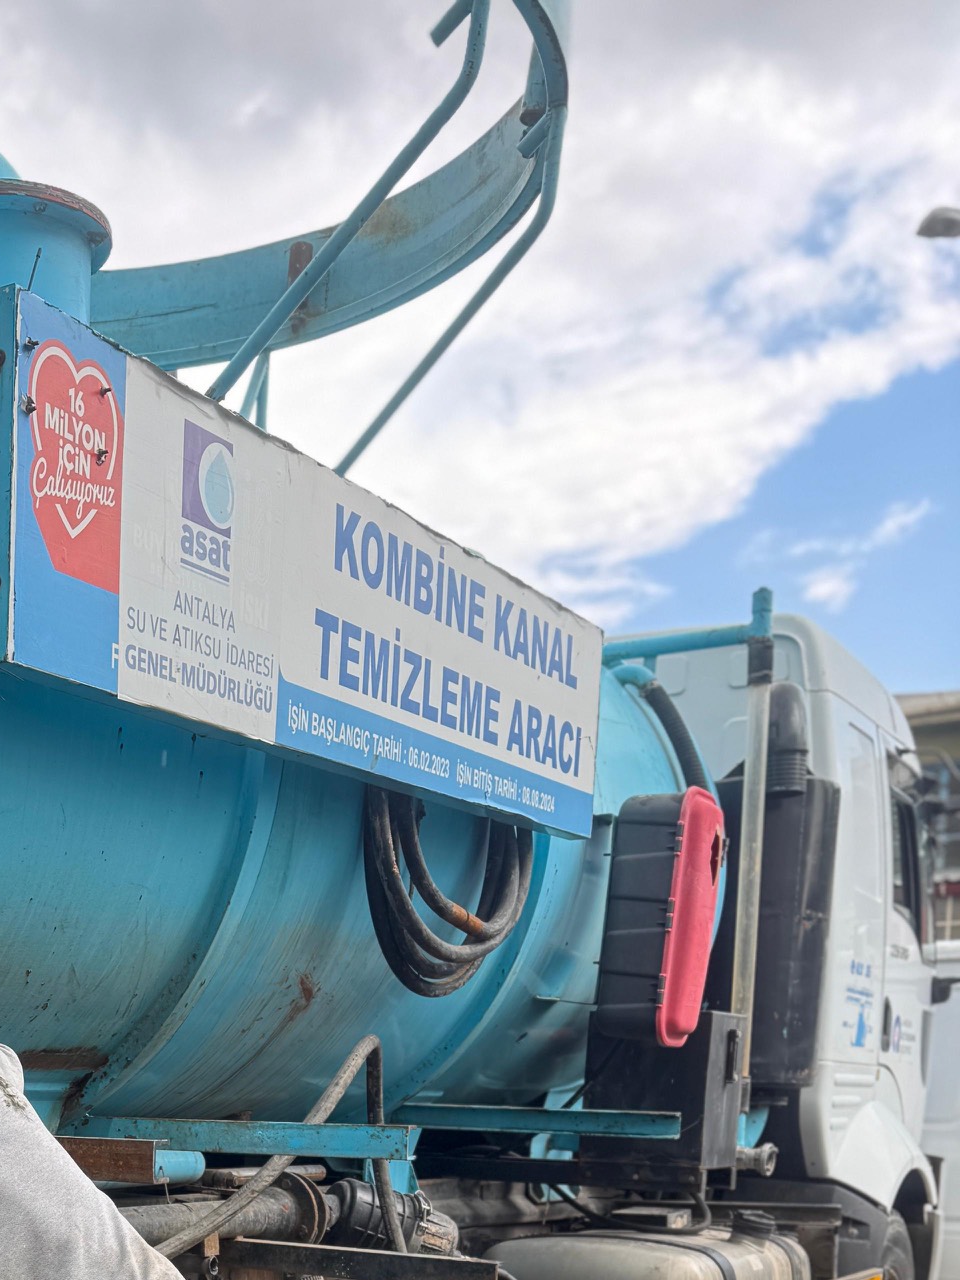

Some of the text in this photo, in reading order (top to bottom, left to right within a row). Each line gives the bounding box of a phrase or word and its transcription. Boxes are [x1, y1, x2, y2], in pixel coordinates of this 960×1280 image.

[68, 388, 85, 417] 16
[32, 456, 115, 520] Çalışıyoruz
[180, 524, 230, 572] asat
[174, 590, 236, 634] ANTALYA
[334, 503, 578, 690] KOMBİNE KANAL
[127, 606, 274, 679] SU VE ATIKSU İDARESİ
[125, 644, 176, 684] GENEL
[182, 662, 273, 713] MÜDÜRLÜĞÜ
[315, 608, 582, 778] TEMİZLEME ARACI
[288, 699, 308, 734] İŞİN
[312, 713, 370, 756] BAŞLANGIÇ
[373, 734, 402, 762] TARİHİ
[408, 747, 450, 778] 06.02.2023
[456, 759, 472, 788] İŞİN
[474, 767, 492, 799] BİTİŞ
[494, 776, 518, 800] TARİHİ
